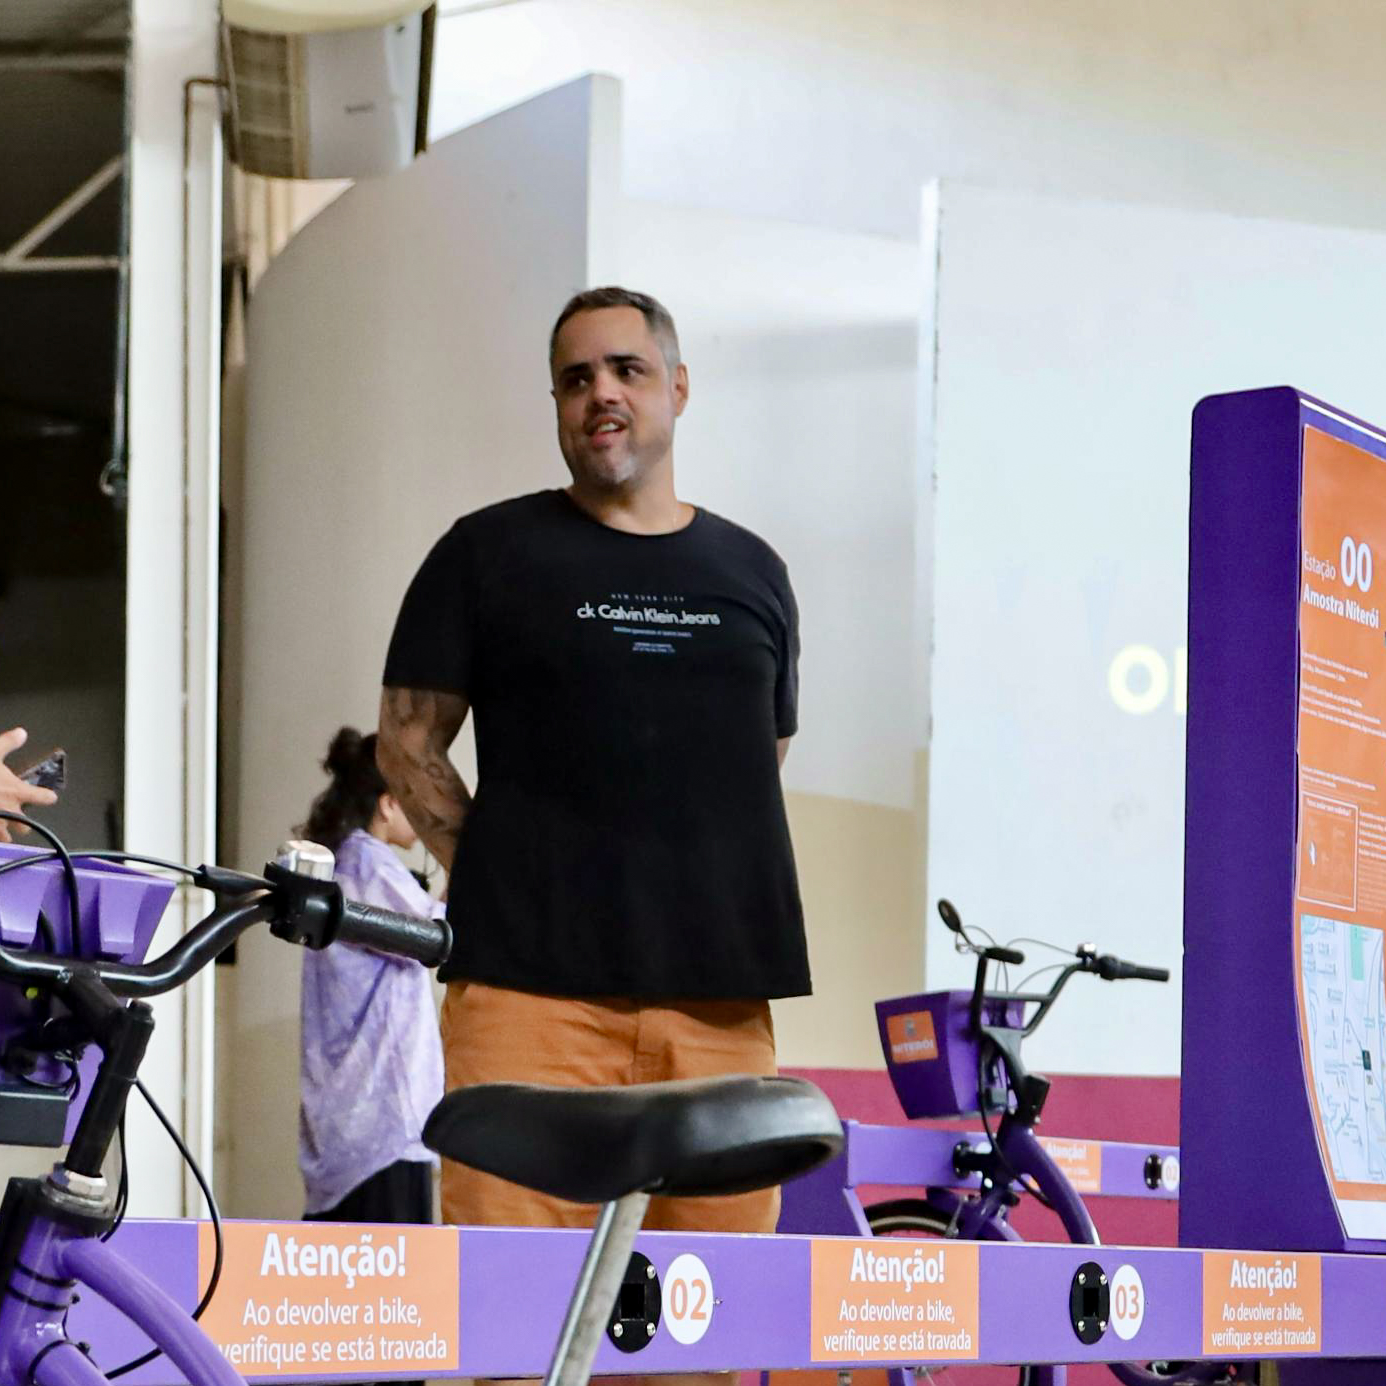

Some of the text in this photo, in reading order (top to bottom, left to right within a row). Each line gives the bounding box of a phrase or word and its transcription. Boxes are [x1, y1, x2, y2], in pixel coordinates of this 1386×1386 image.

[1303, 536, 1372, 592] Estação 00
[577, 602, 721, 625] ck Calvin Klein Jeans
[1303, 583, 1380, 629] Amostra Niterói
[260, 1232, 406, 1289] Atenção!
[850, 1247, 944, 1293] Atenção!
[1230, 1259, 1297, 1297] Atenção!
[243, 1297, 422, 1327] Ao devolver a bike,
[670, 1278, 707, 1321] 02
[839, 1298, 955, 1324] Ao devolver a bike,
[1115, 1285, 1140, 1319] 03
[1222, 1302, 1304, 1323] Ao devolver a bike,
[218, 1332, 447, 1369] verifique se está travada
[823, 1328, 971, 1357] verifique se está travada
[1211, 1326, 1316, 1351] verifique se está travada
